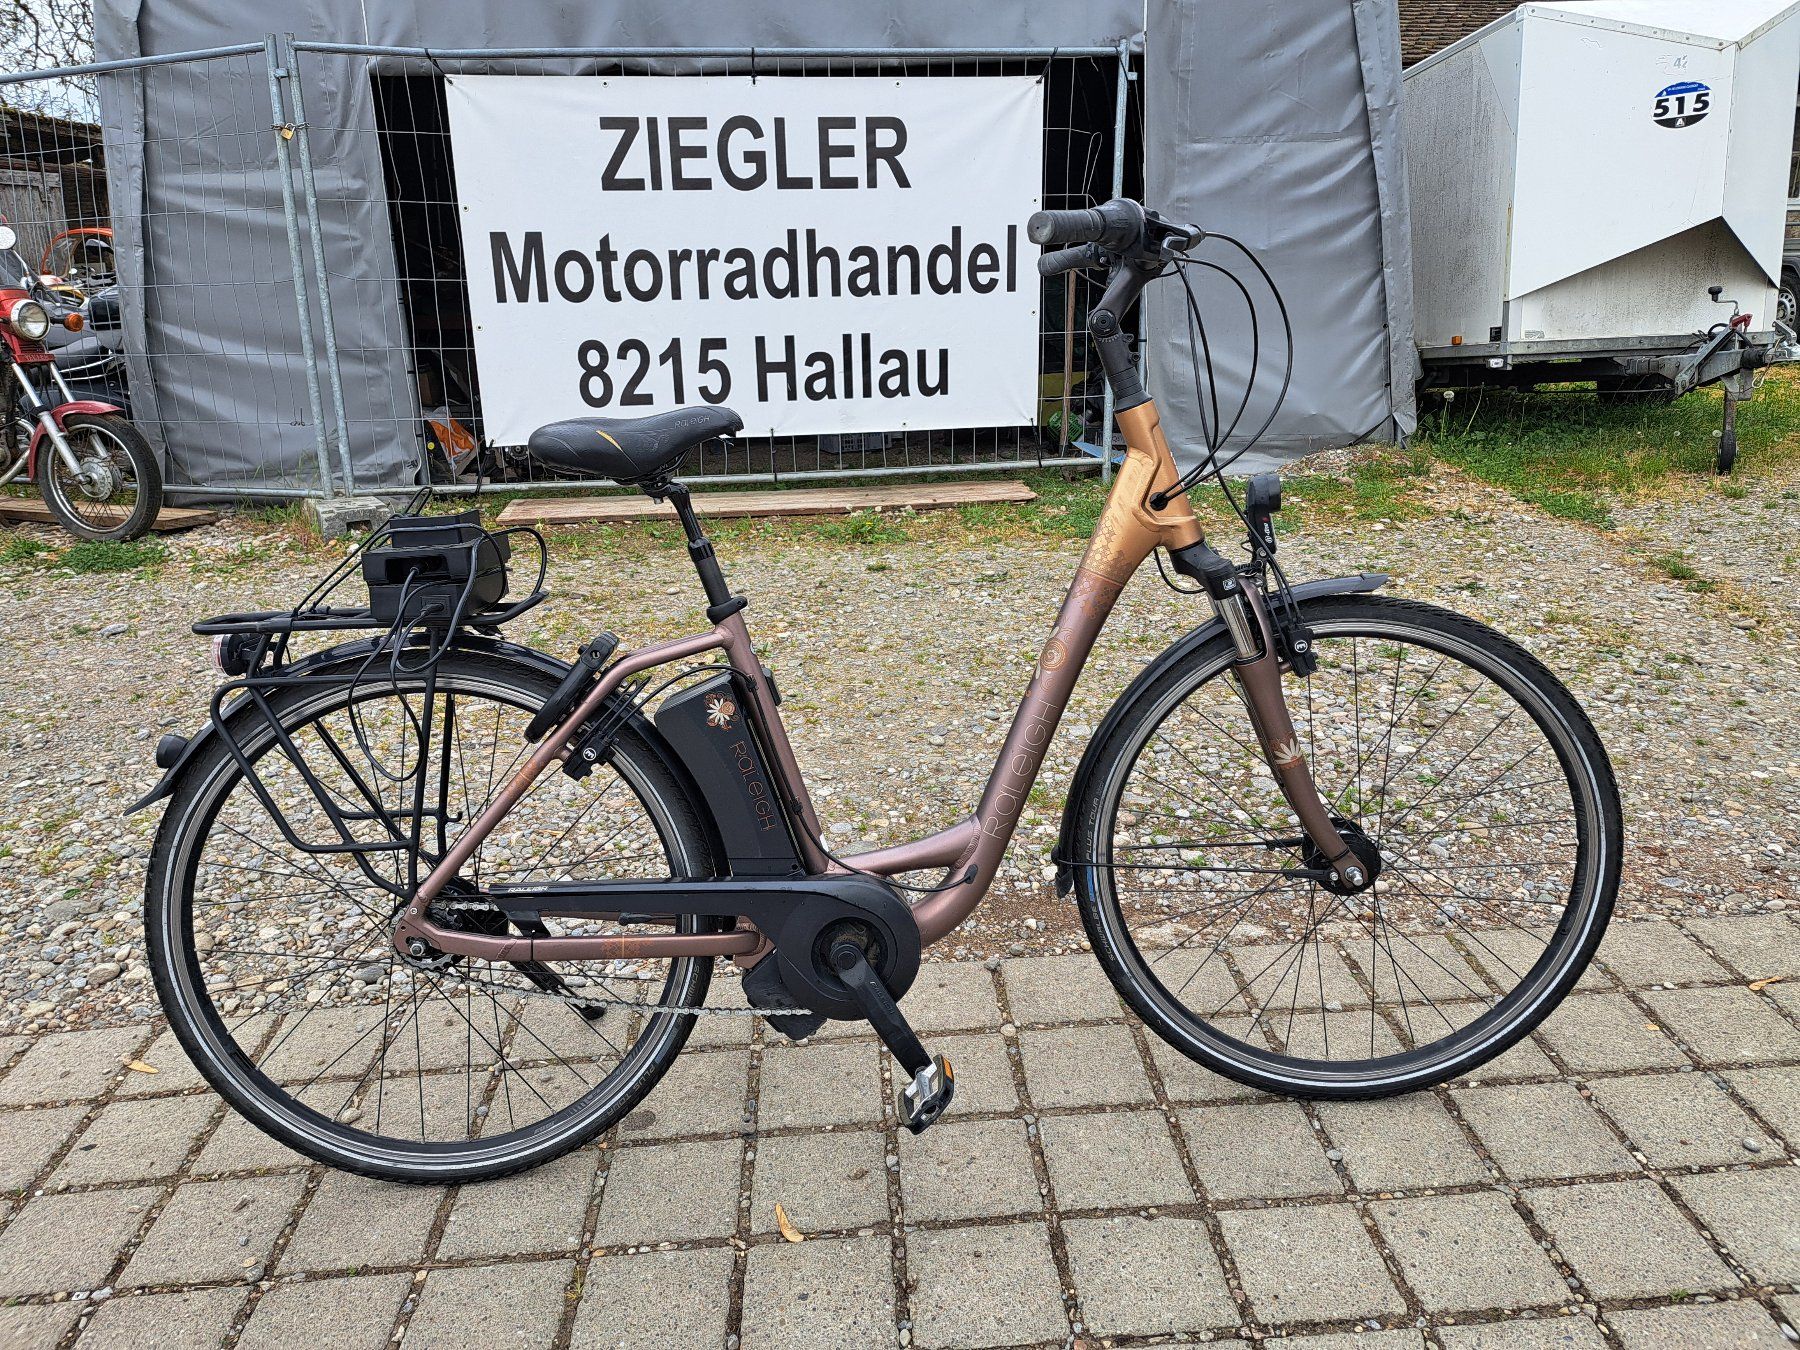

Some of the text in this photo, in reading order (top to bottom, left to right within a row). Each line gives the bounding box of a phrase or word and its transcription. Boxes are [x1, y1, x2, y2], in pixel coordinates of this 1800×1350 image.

[1652, 92, 1710, 118] 515
[599, 114, 911, 192] ZIEGLER
[489, 224, 1018, 303] Motorradhandel
[577, 333, 950, 407] 8215 Hallau
